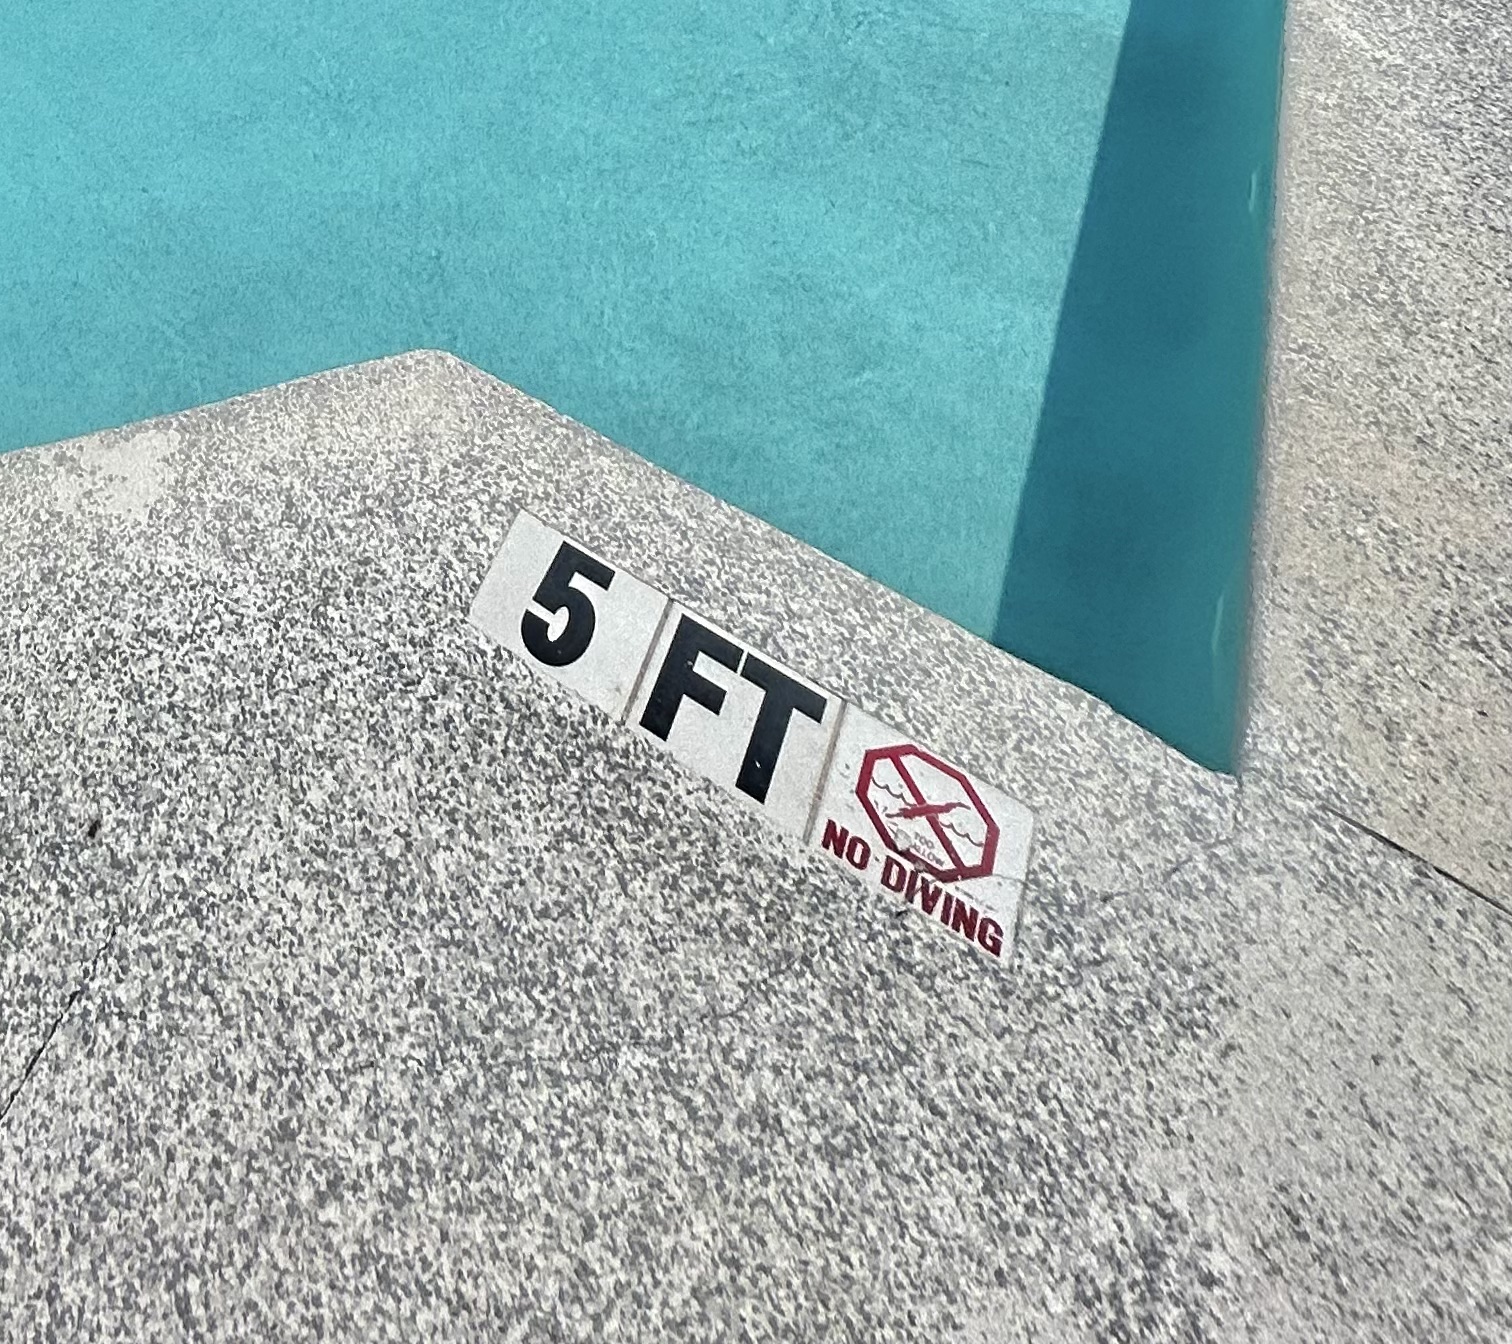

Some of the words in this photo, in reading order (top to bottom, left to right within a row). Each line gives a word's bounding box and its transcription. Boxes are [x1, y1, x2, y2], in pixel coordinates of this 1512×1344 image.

[521, 540, 616, 666] 5
[639, 614, 827, 803] FT
[821, 818, 871, 871] NO
[880, 854, 1004, 958] DIVING
